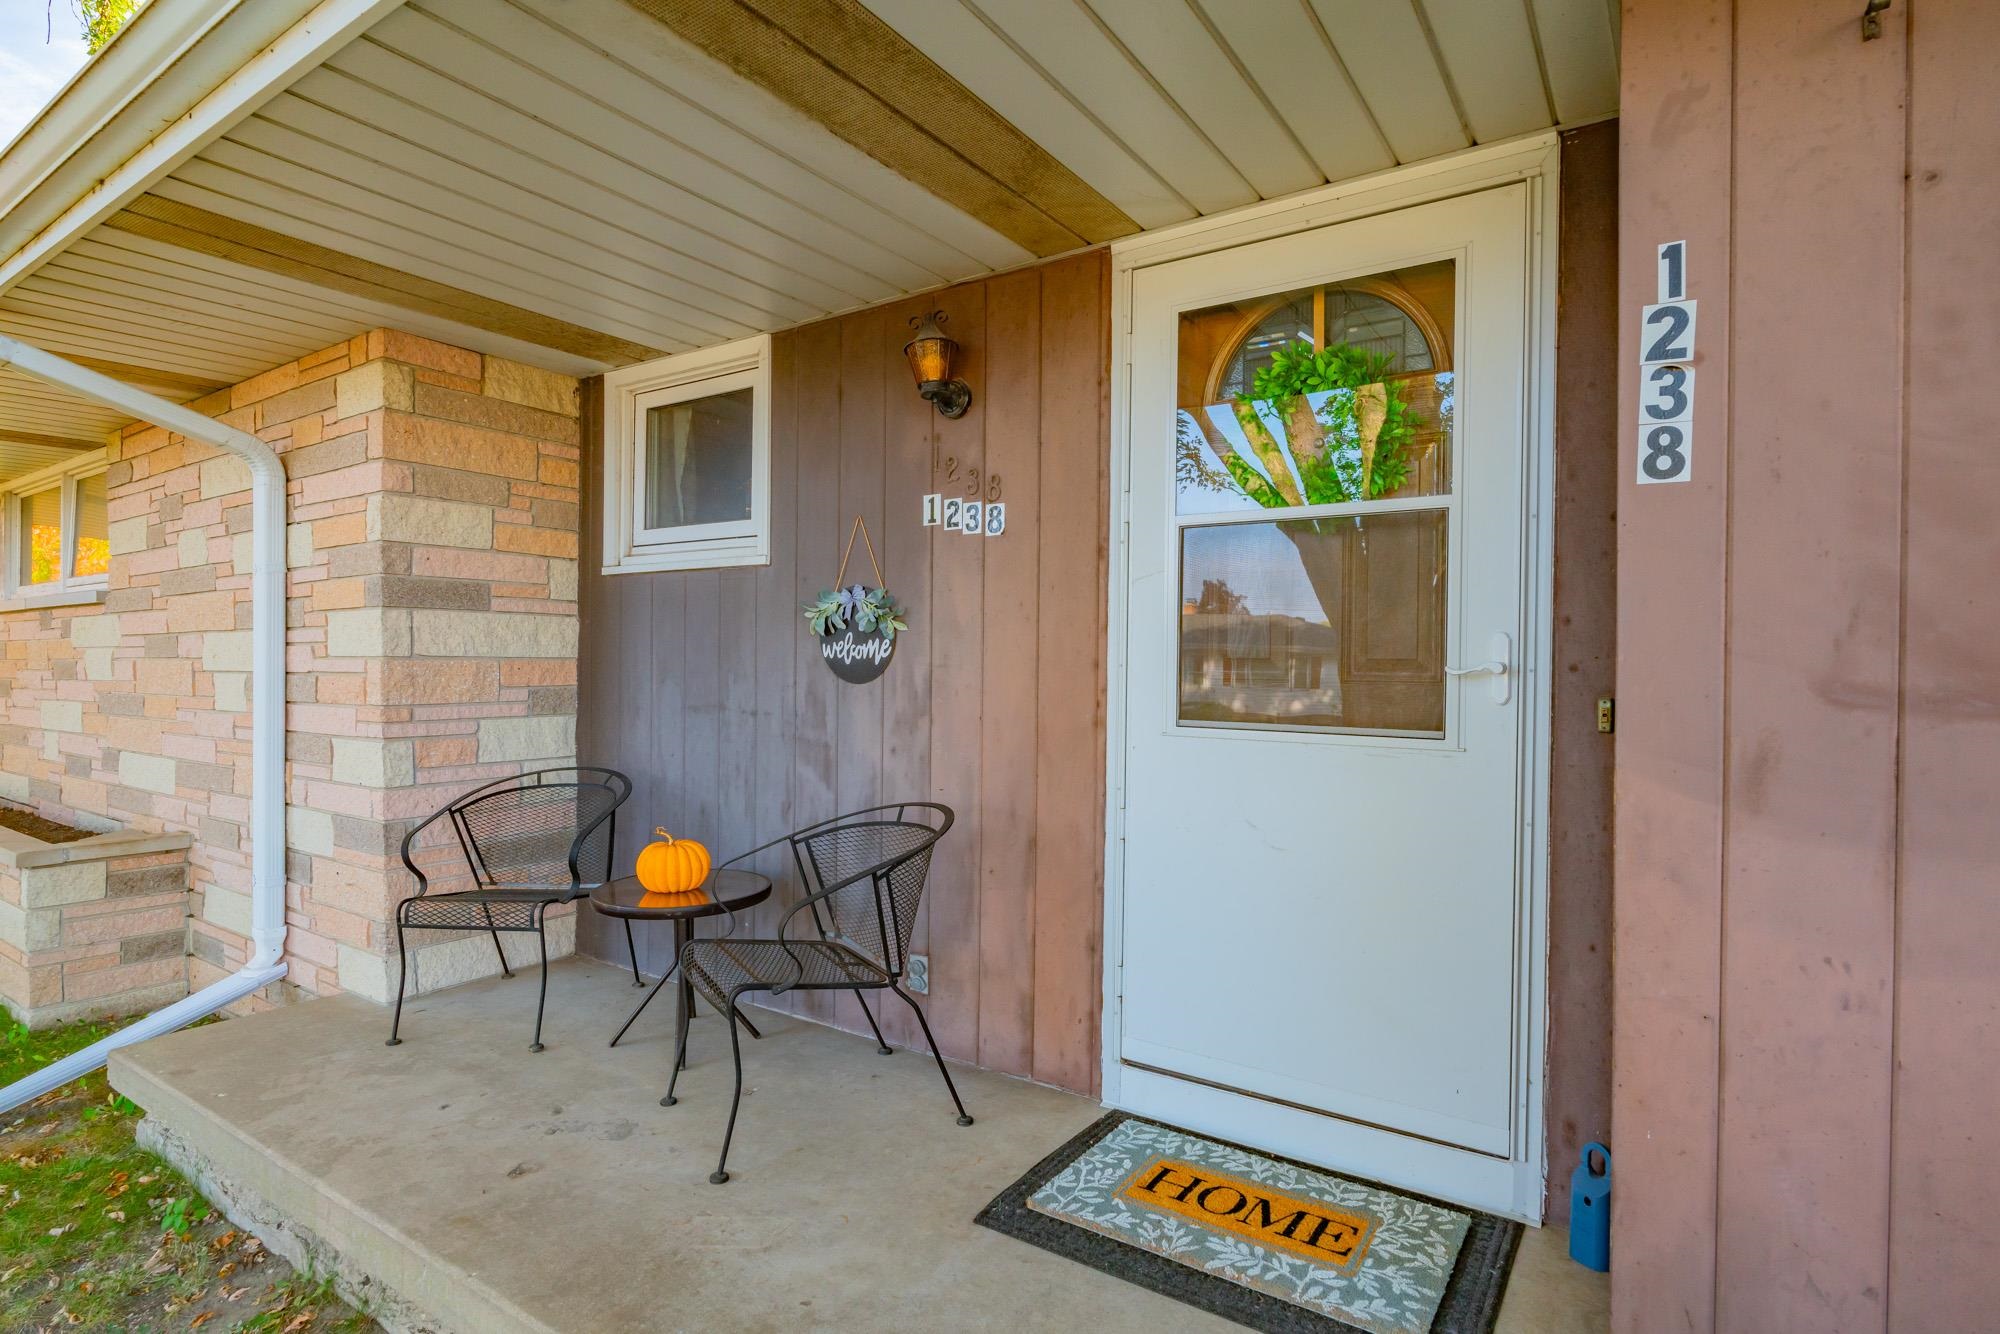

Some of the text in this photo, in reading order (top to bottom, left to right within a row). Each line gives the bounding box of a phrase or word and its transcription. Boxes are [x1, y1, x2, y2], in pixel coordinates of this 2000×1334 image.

[1642, 243, 1689, 480] 1238
[927, 496, 1003, 534] 1238
[822, 632, 892, 666] welcome
[1137, 1165, 1359, 1257] HOME
